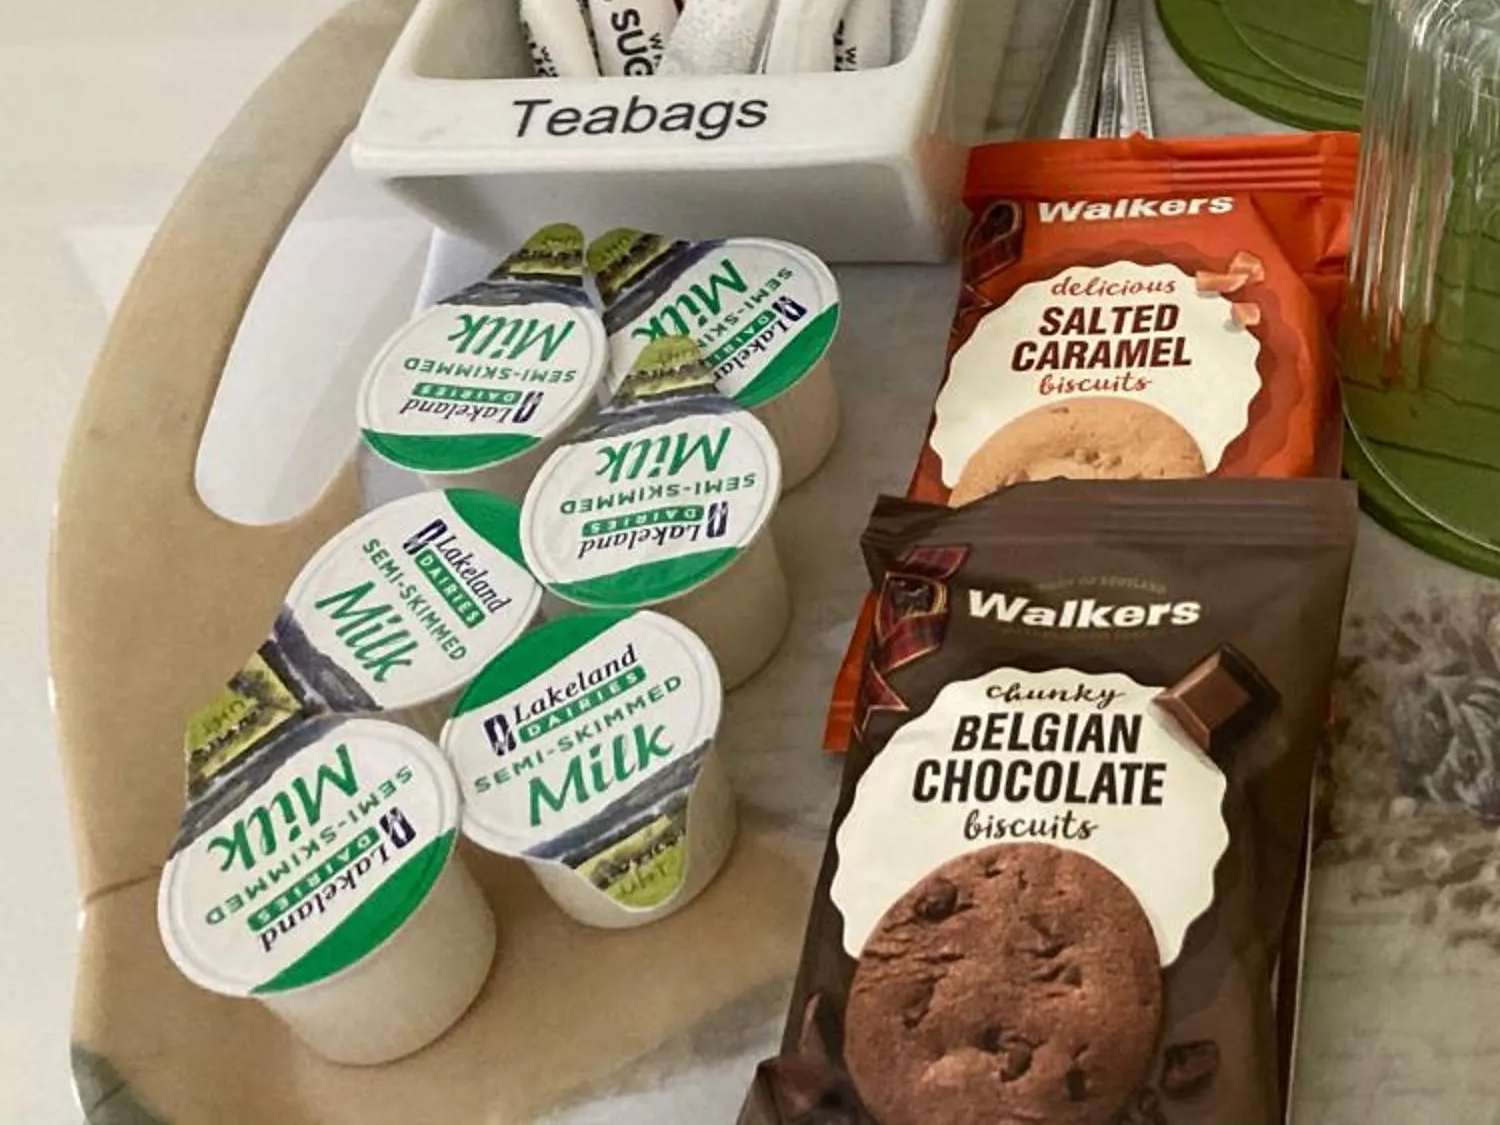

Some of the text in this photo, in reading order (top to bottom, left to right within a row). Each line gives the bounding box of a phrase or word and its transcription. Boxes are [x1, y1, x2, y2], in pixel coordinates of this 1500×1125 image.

[511, 96, 769, 141] Teabags
[1037, 195, 1235, 224] Walkers
[632, 258, 749, 342] Milk
[1050, 274, 1177, 299] delicious
[447, 313, 576, 362] Milk
[1039, 303, 1181, 338] SALTED
[402, 356, 577, 384] SEMI-SKIMMED
[1010, 336, 1193, 373] CARAMEL
[419, 384, 516, 402] DAIRIES
[1038, 370, 1154, 396] biscuits
[399, 397, 514, 424] Lakeland
[595, 426, 732, 484] Milk
[559, 472, 757, 515] SEMI-SKIMMED
[577, 524, 702, 560] Lakeland
[590, 506, 698, 533] DAIRIES
[418, 553, 481, 623] DAIRIES
[436, 534, 513, 614] Lakeland
[362, 538, 468, 662] SEMI-SKIMMED
[967, 588, 1203, 628] Walkers
[314, 580, 419, 683] Milk
[513, 642, 639, 725] Lakeland
[527, 671, 640, 738] DAIRIES
[985, 682, 1127, 711] chunky
[474, 675, 683, 794] SEMI-SKIMMED
[951, 711, 1143, 755] BELGIAN
[528, 722, 674, 828] Milk
[911, 759, 1168, 807] CHOCOLATE
[207, 742, 359, 873] Milk
[963, 808, 1099, 843] biscuits
[205, 764, 414, 926] SEMI-SKIMMED
[256, 832, 374, 925] DAIRIES
[259, 842, 391, 954] Lakeland
